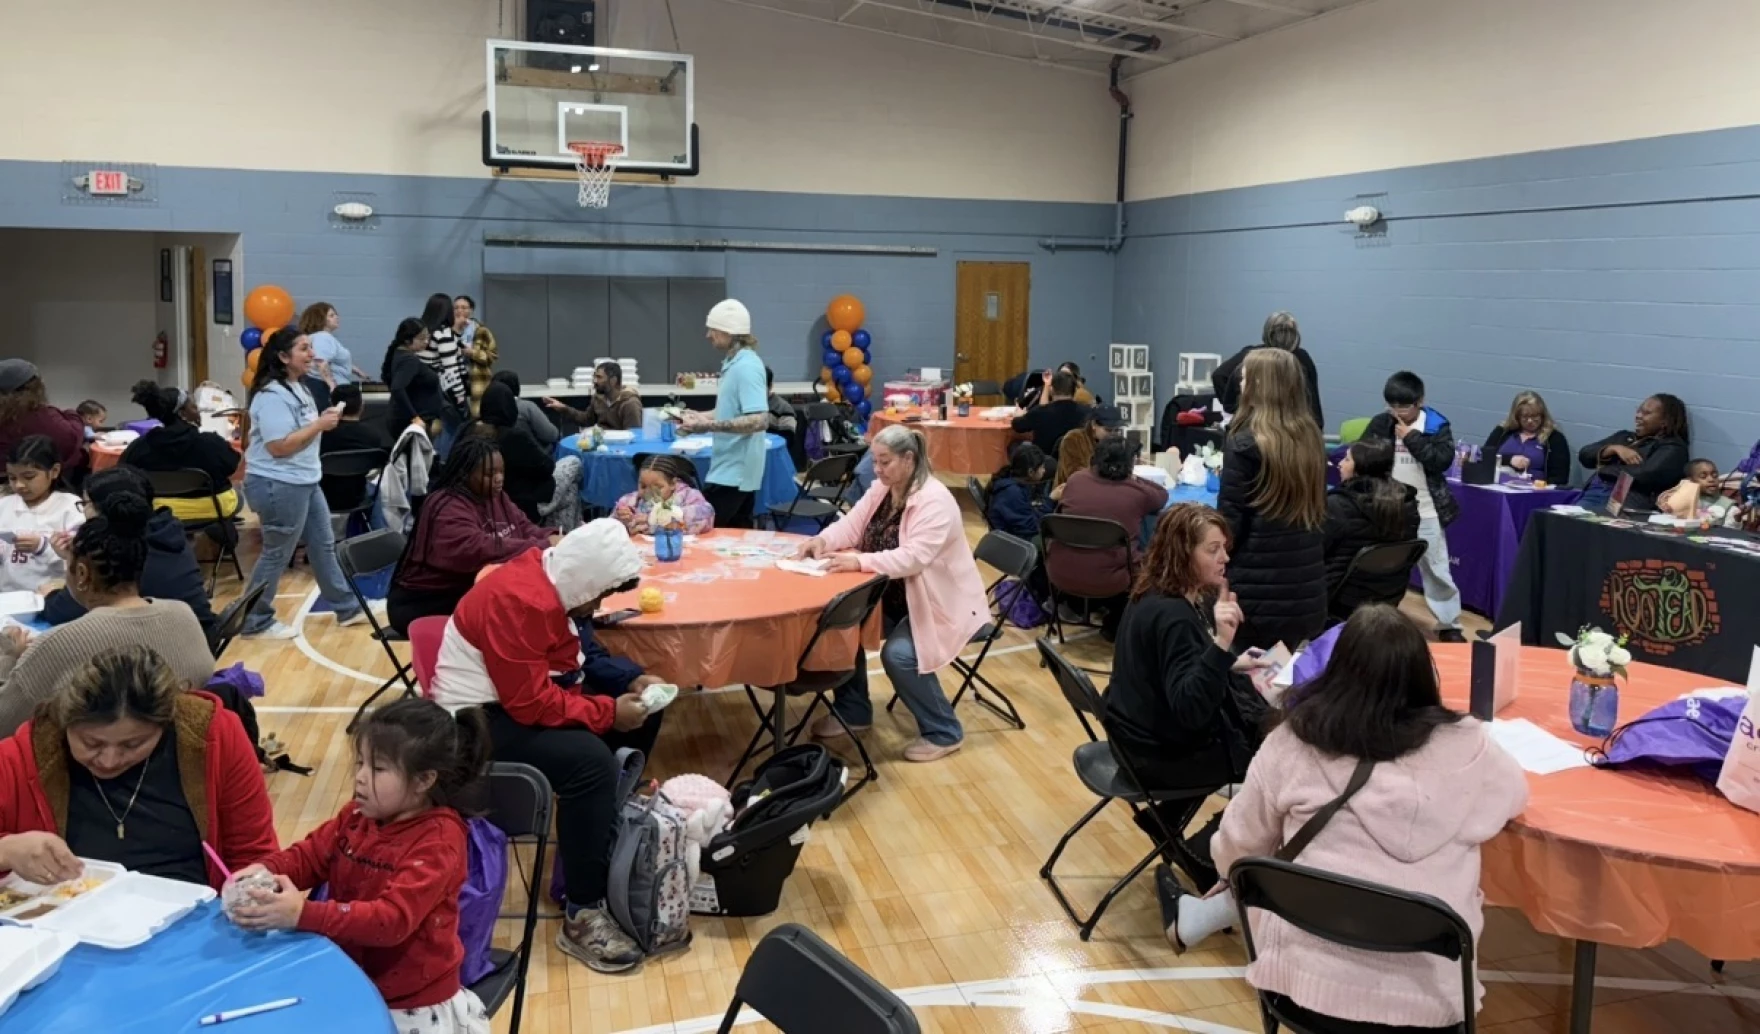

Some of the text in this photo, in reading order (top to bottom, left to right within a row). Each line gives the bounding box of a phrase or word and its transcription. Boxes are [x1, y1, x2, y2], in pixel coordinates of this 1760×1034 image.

[95, 172, 122, 190] EXIT
[1114, 352, 1122, 366] B
[1118, 379, 1126, 393] A
[1120, 406, 1129, 420] B
[1740, 715, 1760, 739] a
